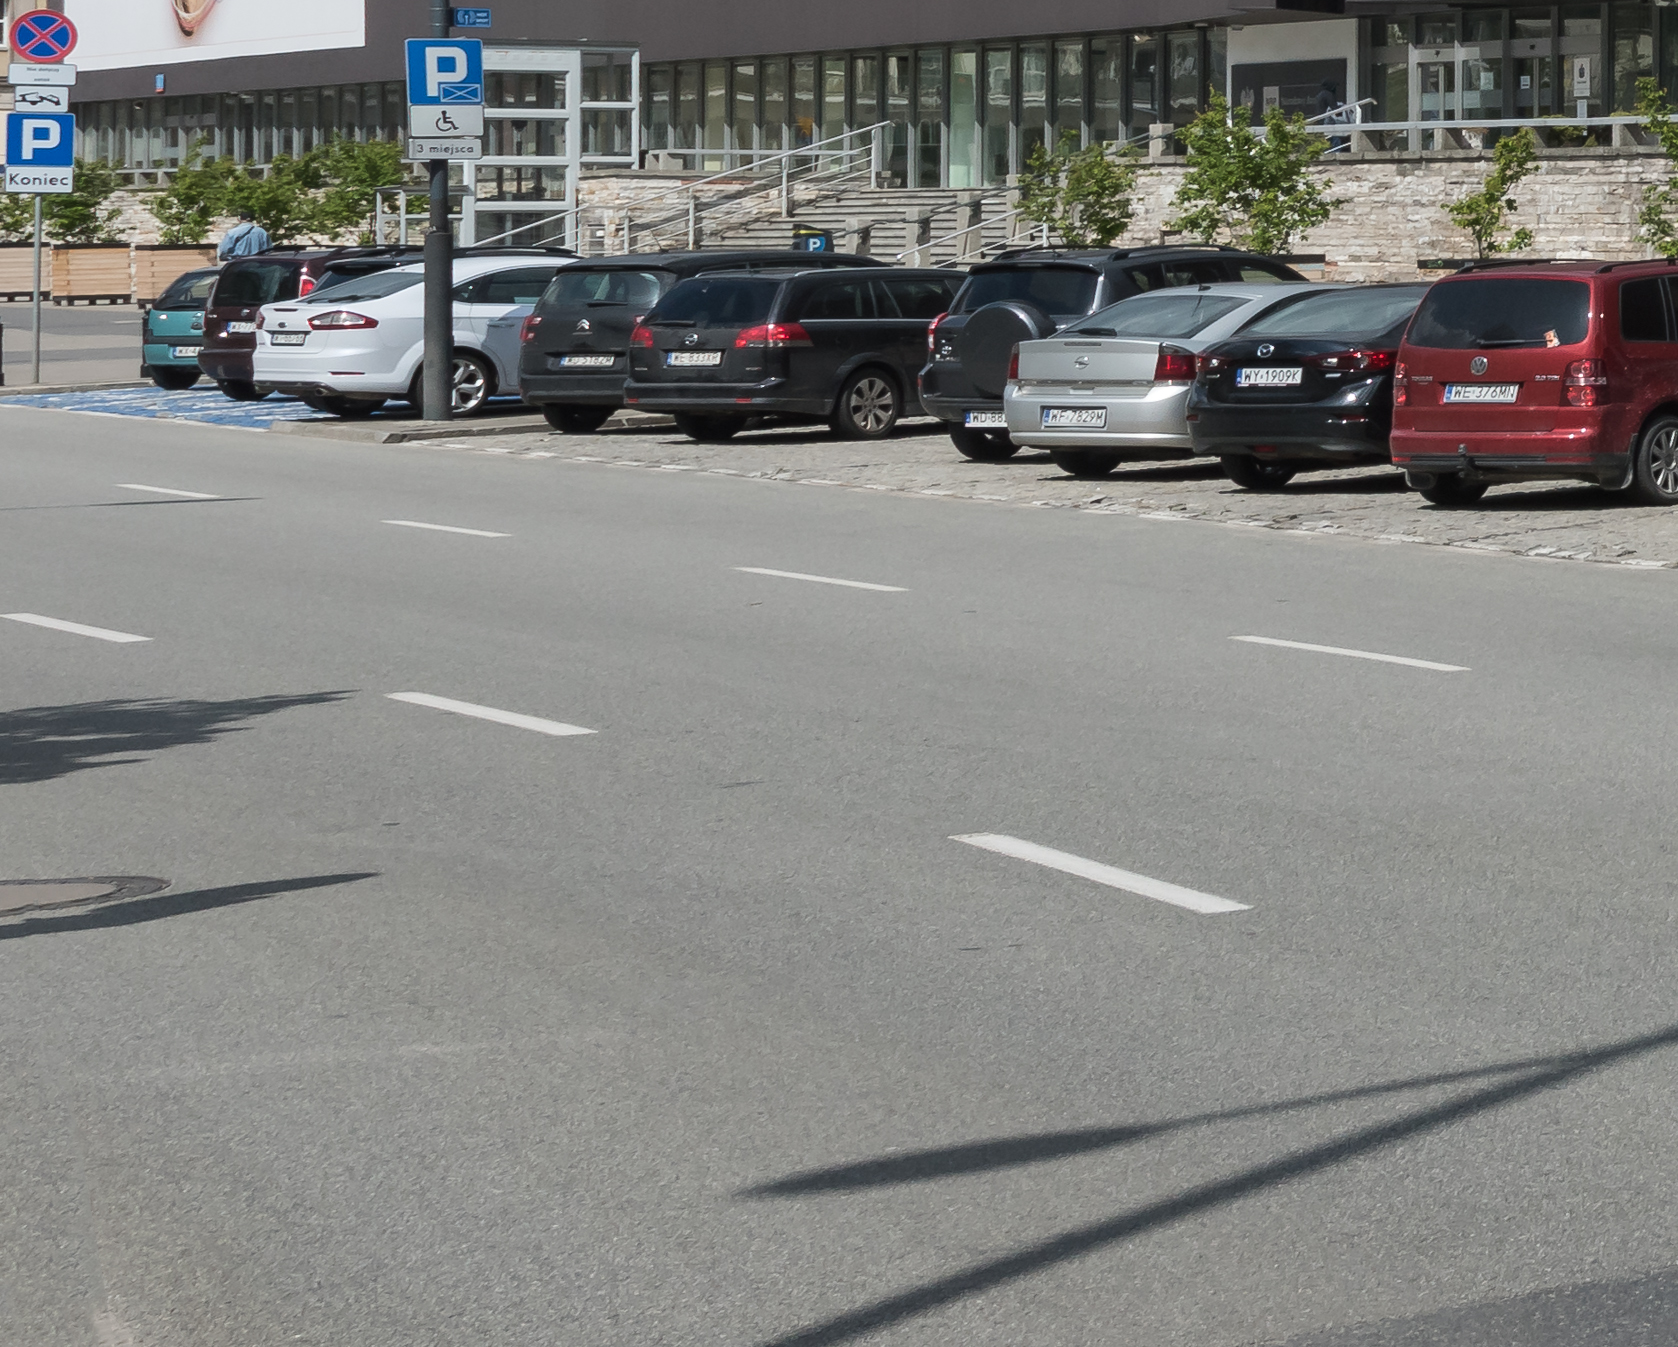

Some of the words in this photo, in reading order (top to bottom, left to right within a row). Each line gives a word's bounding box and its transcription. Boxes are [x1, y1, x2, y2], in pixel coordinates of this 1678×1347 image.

[425, 46, 468, 97] P
[21, 119, 61, 160] P
[416, 144, 424, 153] 3
[429, 143, 474, 155] miejsca
[9, 173, 69, 186] Koniec
[809, 238, 820, 251] P
